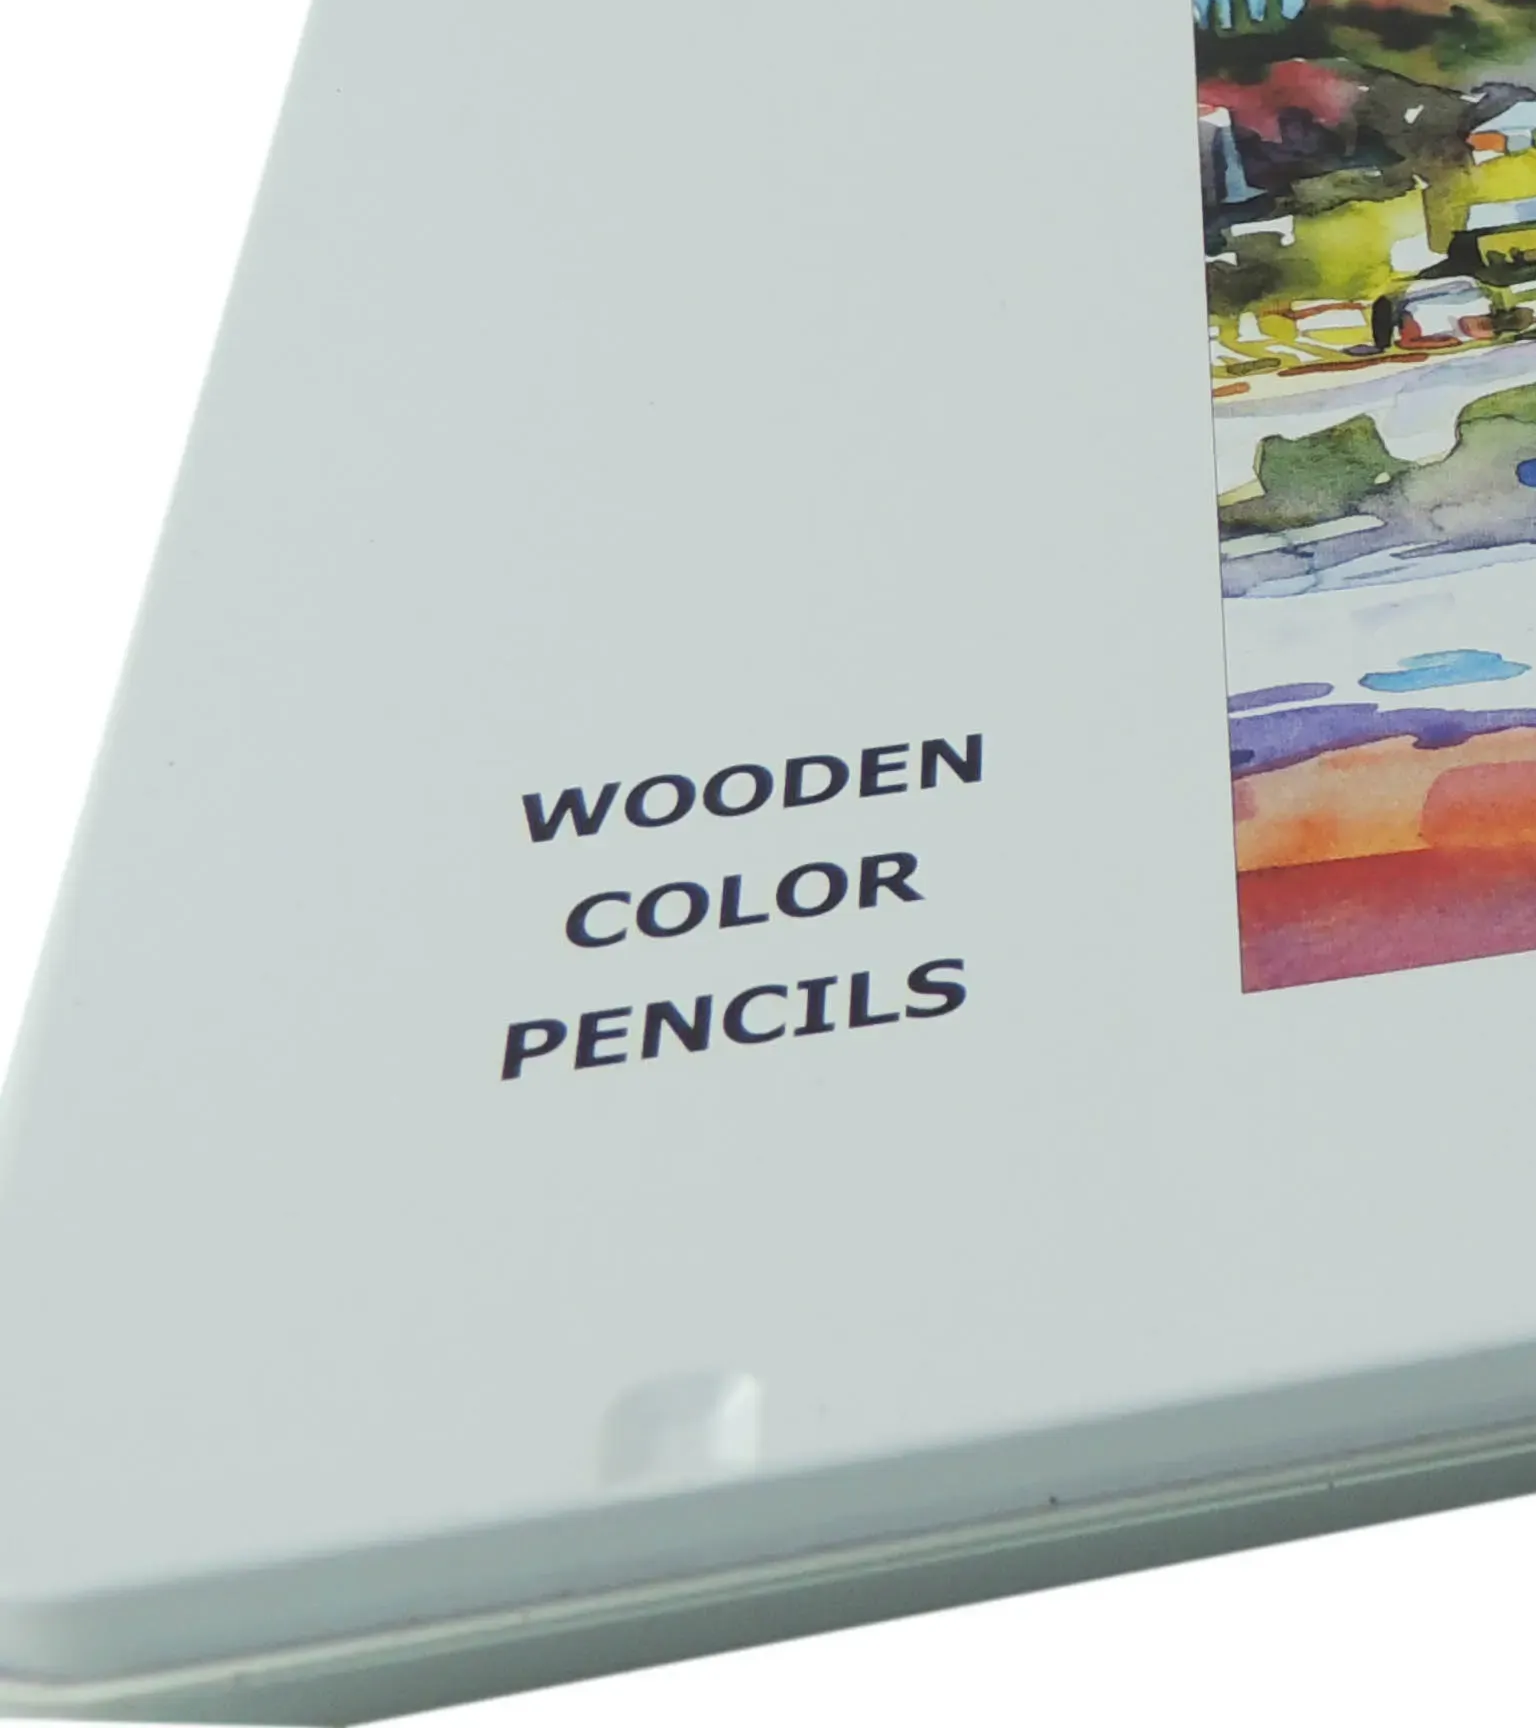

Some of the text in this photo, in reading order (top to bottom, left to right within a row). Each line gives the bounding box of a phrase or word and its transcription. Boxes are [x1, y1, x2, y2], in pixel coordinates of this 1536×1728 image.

[520, 732, 984, 844] WOODEN
[564, 850, 927, 949] COLOR
[500, 957, 968, 1082] PENCILS
